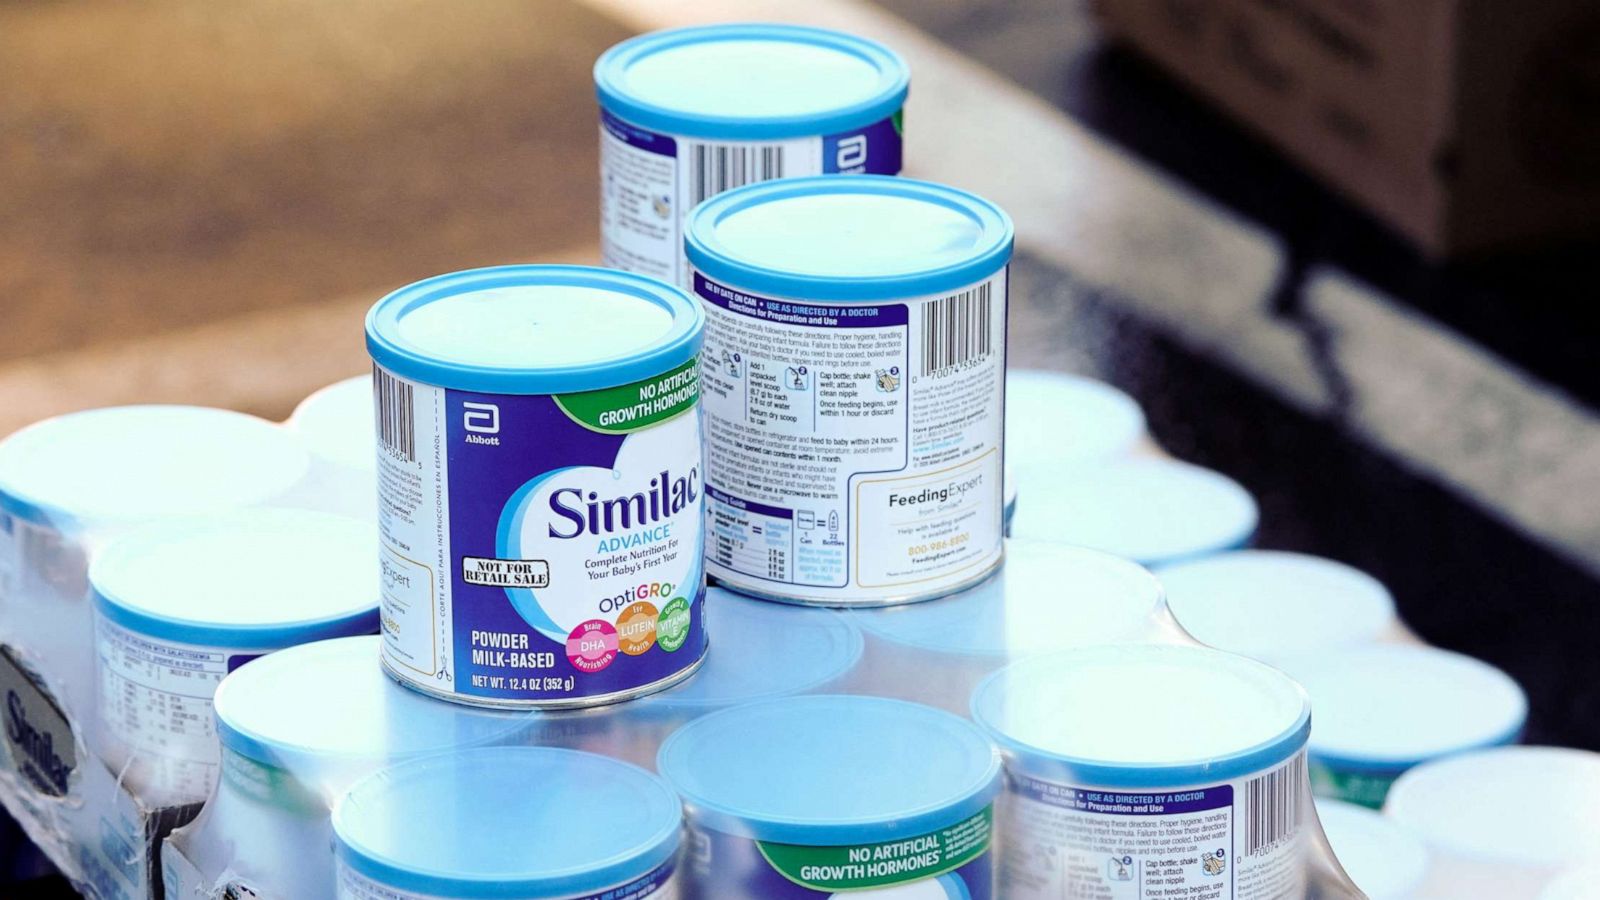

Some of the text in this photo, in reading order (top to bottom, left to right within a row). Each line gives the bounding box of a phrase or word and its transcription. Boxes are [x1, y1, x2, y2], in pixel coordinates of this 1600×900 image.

[713, 286, 720, 295] BY
[720, 288, 734, 300] DATE
[734, 293, 744, 303] ON
[743, 295, 757, 306] CAN
[766, 302, 779, 310] USE
[781, 304, 791, 313] AS
[792, 305, 827, 316] DIRECTED
[829, 308, 839, 317] BY
[840, 308, 847, 317] A
[848, 308, 879, 317] DOCTOR
[728, 300, 838, 325] Directions for Preparation and Use
[833, 331, 902, 342] Proper handling
[811, 340, 902, 349] Failure directions
[750, 361, 760, 369] Add
[750, 371, 776, 382] unpacked
[820, 371, 871, 380] Cap bottle; shake
[912, 376, 917, 384] 0
[930, 366, 959, 380] 70074
[764, 382, 780, 392] scoop
[820, 381, 857, 389] well; attach
[640, 384, 656, 401] NO
[774, 393, 788, 401] each
[838, 390, 858, 398] nipple
[774, 402, 790, 410] water
[820, 400, 836, 408] Once
[838, 401, 861, 409] feeding
[862, 400, 886, 409] begins,
[599, 402, 652, 426] GROWTH
[750, 406, 797, 423] Return scoop
[820, 409, 840, 417] within
[847, 409, 861, 417] hour
[871, 408, 894, 417] discard
[465, 435, 500, 446] Abbott
[811, 436, 825, 444] feed
[833, 438, 848, 446] baby
[773, 449, 816, 461] contents within
[435, 471, 442, 482] EN
[779, 488, 811, 498] microwave
[889, 474, 982, 507] FeedingExpert
[549, 466, 697, 539] Similac
[435, 485, 443, 546] INSTRUCCIONES
[919, 508, 935, 517] from
[930, 520, 952, 529] feeding
[954, 511, 976, 523] questions
[597, 523, 672, 554] ADVANCE
[929, 528, 953, 539] available
[585, 539, 679, 569] Complete Nutrition For
[912, 546, 966, 564] FeedingExpert.com
[478, 561, 532, 574] NOT FOR
[588, 552, 678, 580] Your Baby's First Year
[465, 570, 546, 584] RETAIL SALE
[583, 622, 602, 631] Brain
[621, 621, 655, 636] LUTEIN
[672, 625, 679, 636] E
[472, 630, 529, 649] POWDER
[580, 640, 606, 652] DHA
[472, 649, 555, 668] MILK-BASED
[575, 653, 612, 669] Nourishing
[472, 675, 574, 690] NET WT. 12.4 OZ (352 g)
[1086, 793, 1102, 802] USE
[1103, 794, 1114, 803] AS
[1115, 795, 1154, 804] DIRECTED
[1154, 795, 1165, 803] BY
[1167, 795, 1173, 803] A
[1174, 792, 1204, 802] DOCTOR
[1076, 799, 1087, 808] for
[1088, 801, 1132, 812] Preparation
[1133, 804, 1148, 812] and
[1149, 804, 1164, 812] Use
[1128, 813, 1227, 829] directions. Proper handling
[1201, 822, 1227, 831] directions
[1193, 834, 1211, 843] boiled
[1211, 831, 1226, 840] water
[849, 848, 870, 863] NO
[872, 834, 940, 861] ARTIFICIAL
[1167, 845, 1186, 854] before
[800, 850, 940, 881] GROWTH HORMONES
[1145, 858, 1198, 868] Cap bottle; shake
[1237, 856, 1241, 864] 0
[1145, 868, 1184, 877] well; attach
[1165, 876, 1185, 885] nipple
[1145, 889, 1162, 897] Once
[1164, 888, 1188, 896] feeding
[1190, 885, 1211, 894] begins,
[1197, 891, 1220, 900] discard
